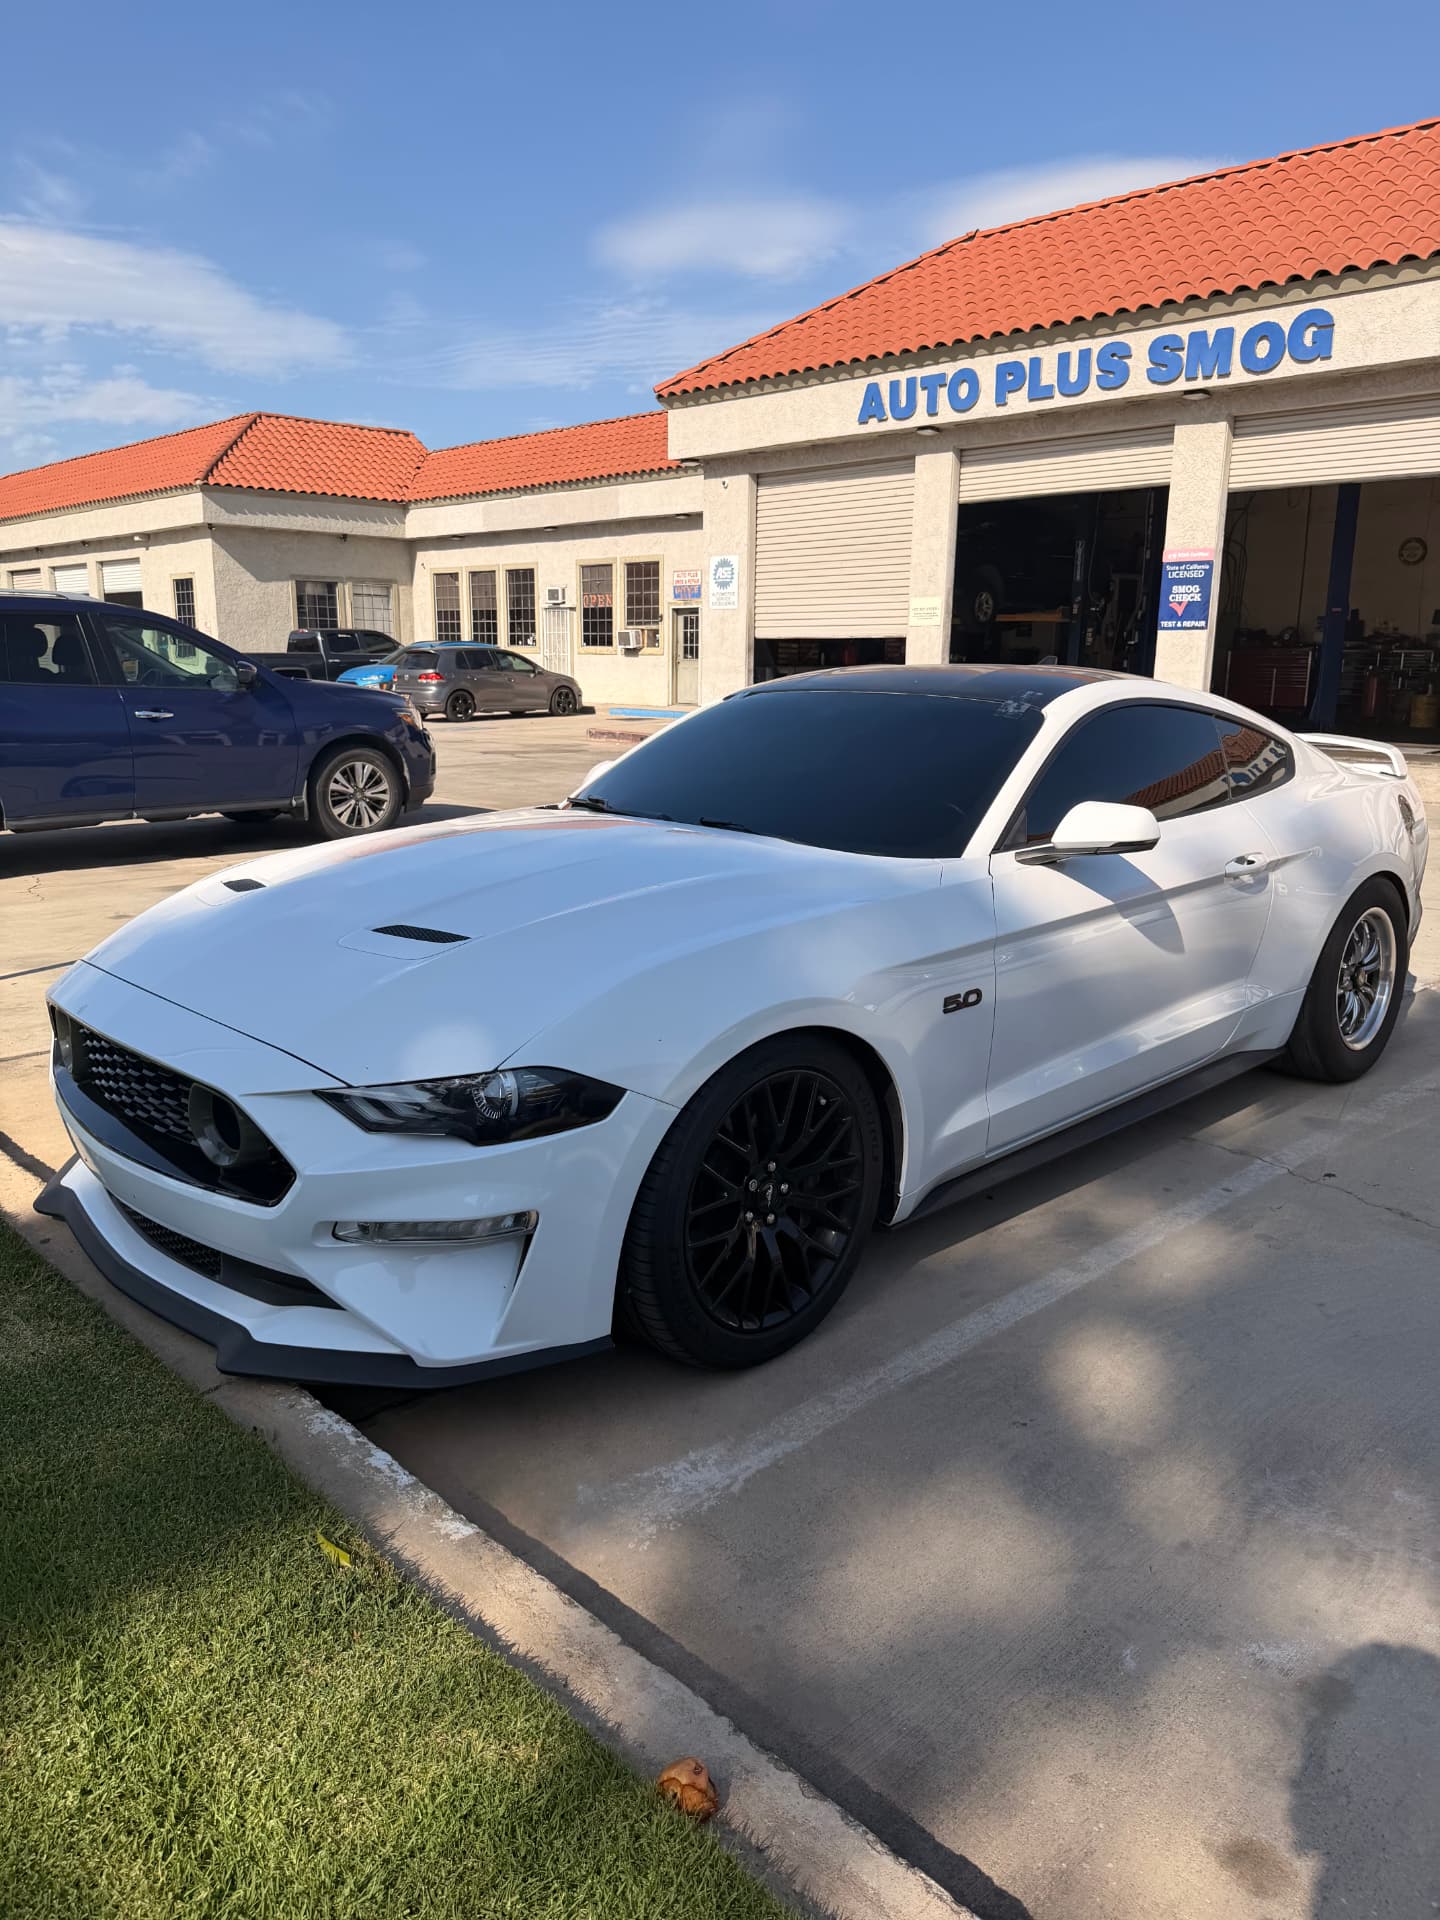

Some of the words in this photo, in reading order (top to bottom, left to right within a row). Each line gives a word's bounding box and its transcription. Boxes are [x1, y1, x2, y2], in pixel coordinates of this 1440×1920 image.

[857, 367, 982, 424] AUTO
[995, 341, 1133, 406] PLUS
[1146, 308, 1335, 384] SMOG
[1168, 570, 1205, 579] LICENSED
[1172, 585, 1201, 594] SMOG
[583, 593, 613, 608] OPEN
[1168, 593, 1202, 602] CHECK
[1183, 620, 1206, 628] REPAIR
